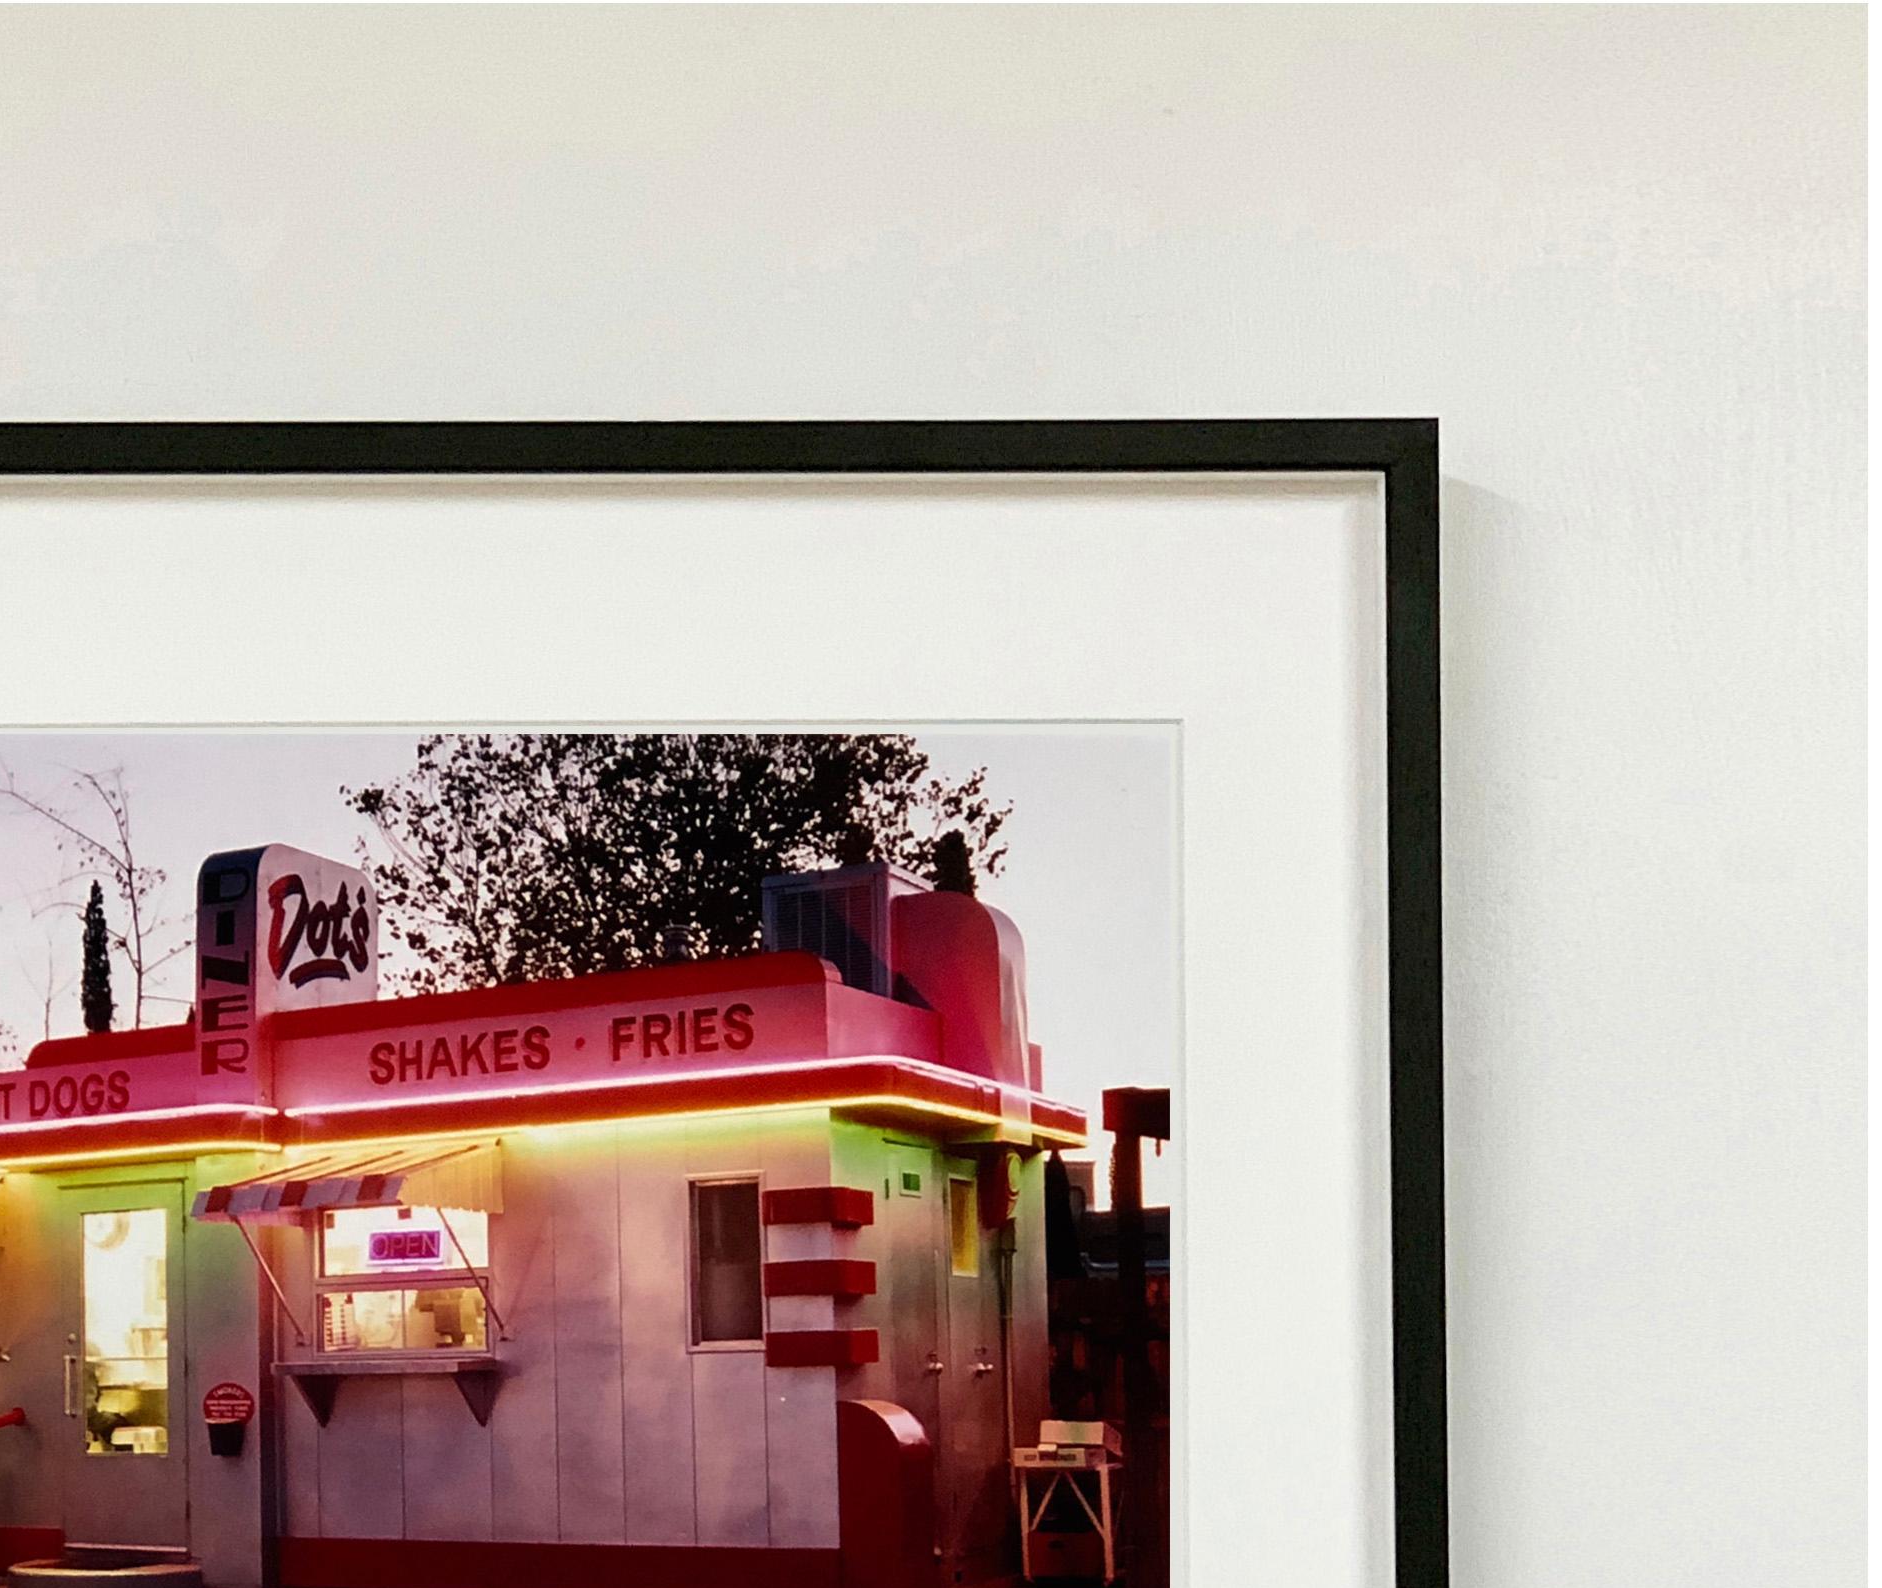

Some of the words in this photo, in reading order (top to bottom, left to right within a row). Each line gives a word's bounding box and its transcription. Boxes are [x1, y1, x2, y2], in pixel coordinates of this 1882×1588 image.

[268, 874, 370, 981] Dot's
[200, 867, 251, 1076] DINER
[369, 1024, 552, 1086] SHAKES
[609, 1001, 756, 1062] FRIES
[28, 1069, 131, 1119] DOGS
[370, 1233, 438, 1259] OPEN
